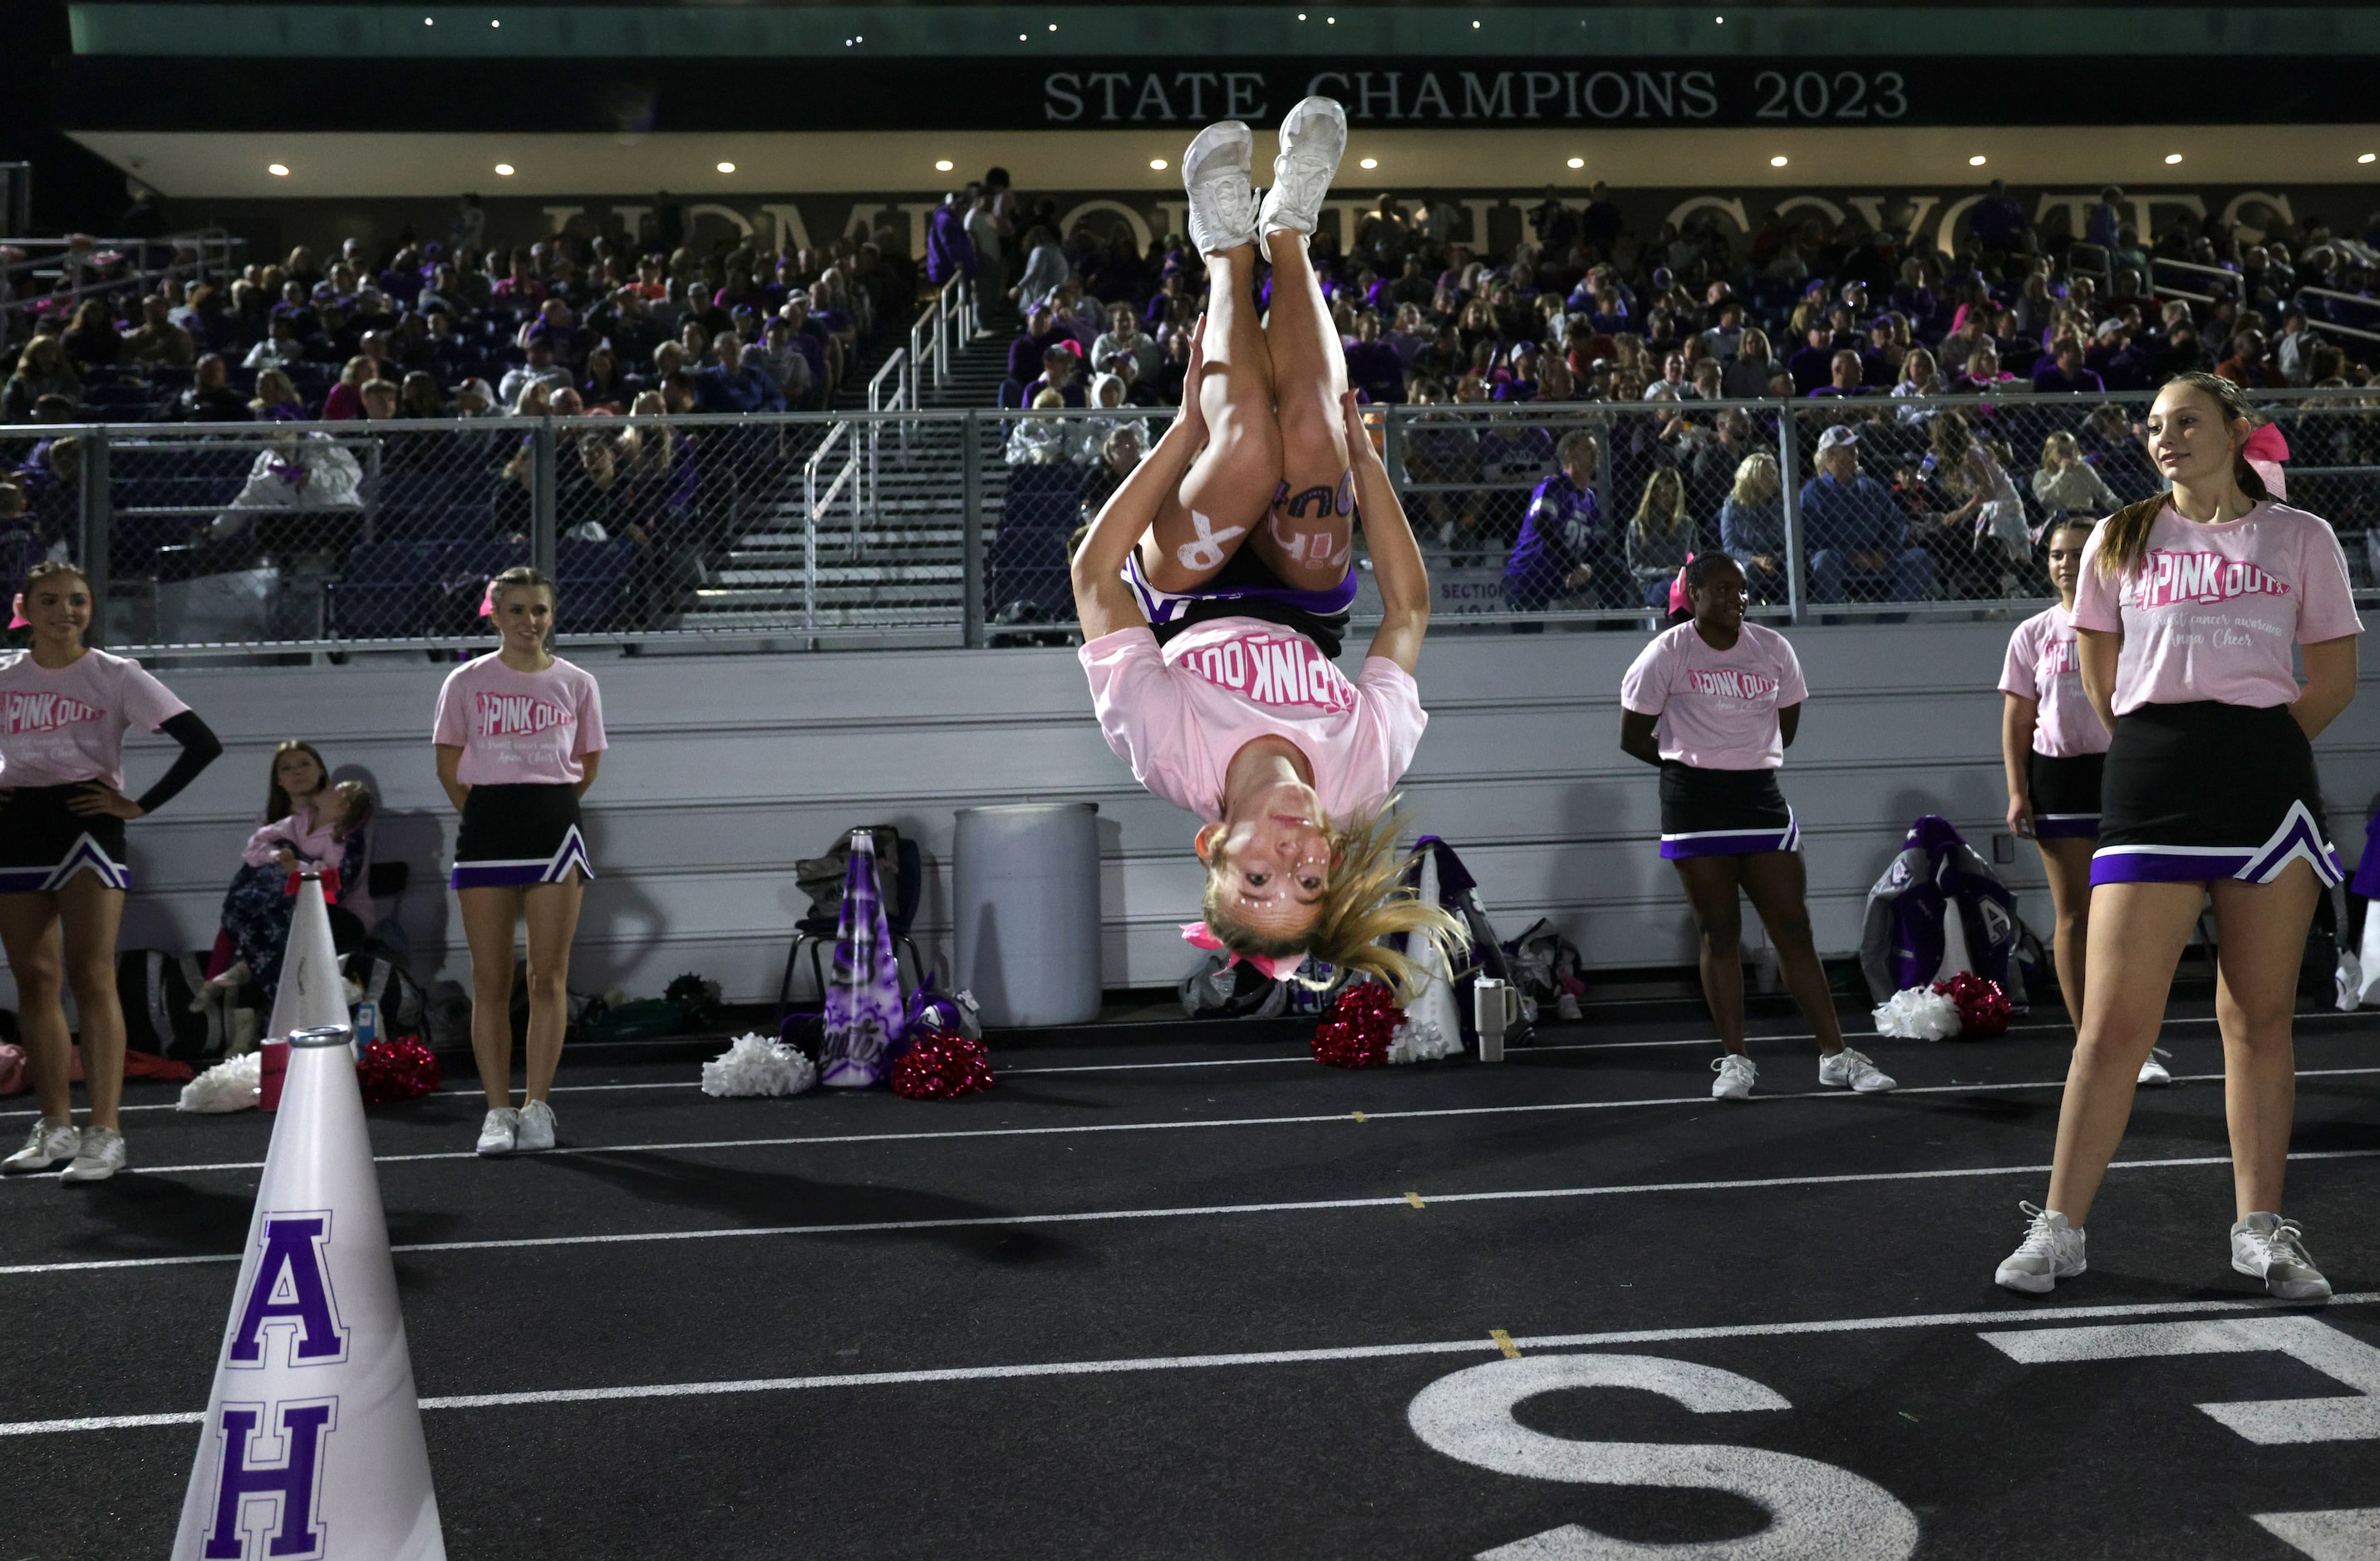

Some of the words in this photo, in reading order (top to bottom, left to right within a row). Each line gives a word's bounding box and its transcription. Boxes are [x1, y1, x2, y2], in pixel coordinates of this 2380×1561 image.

[1044, 71, 1267, 121] STATE
[1306, 70, 1718, 120] CHAMPIONS
[1754, 71, 1908, 118] 2023
[2151, 553, 2223, 605] PINK
[2225, 563, 2277, 598] OUT
[2191, 613, 2230, 627] cancer
[2234, 615, 2284, 638] awareness
[2212, 628, 2255, 649] Cheer
[1187, 640, 1246, 689] OUT
[1247, 639, 1335, 704] PINK
[1701, 671, 1744, 698] PINK
[7, 693, 57, 733] PINK
[56, 699, 96, 726] OUT
[488, 697, 534, 735] PINK
[534, 703, 568, 731] OUT
[1978, 894, 2012, 946] A
